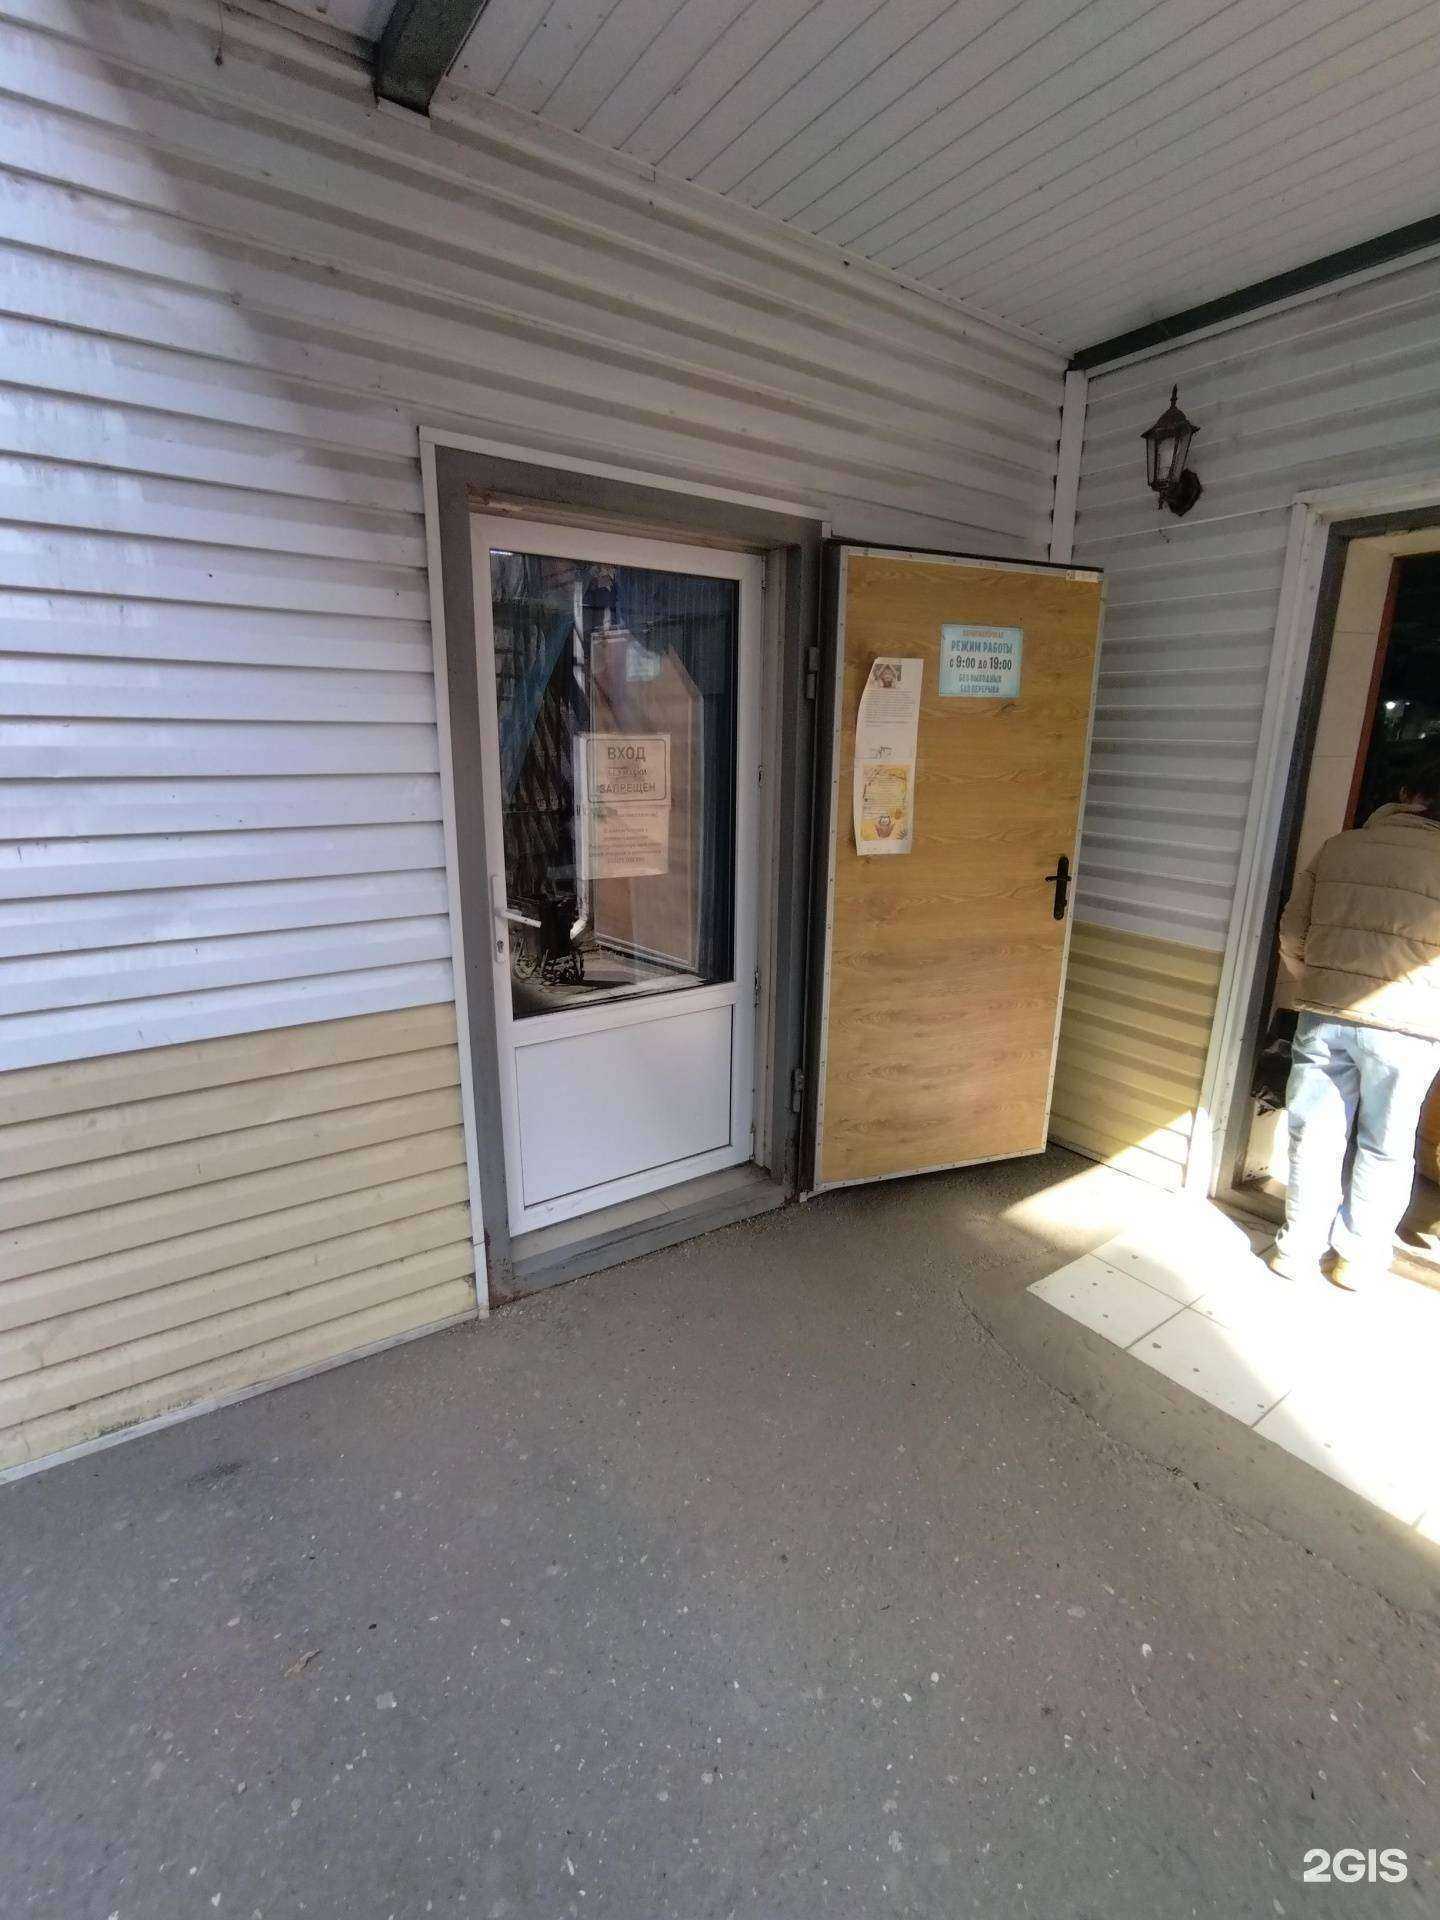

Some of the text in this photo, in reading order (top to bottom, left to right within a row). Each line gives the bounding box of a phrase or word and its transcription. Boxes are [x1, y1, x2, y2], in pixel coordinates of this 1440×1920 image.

[951, 640, 1013, 654] РЕЖИМ РАБОТЫ
[956, 655, 976, 669] 9:00
[607, 746, 646, 762] ВХОД
[600, 782, 656, 794] ЗАПРЕЩЕН
